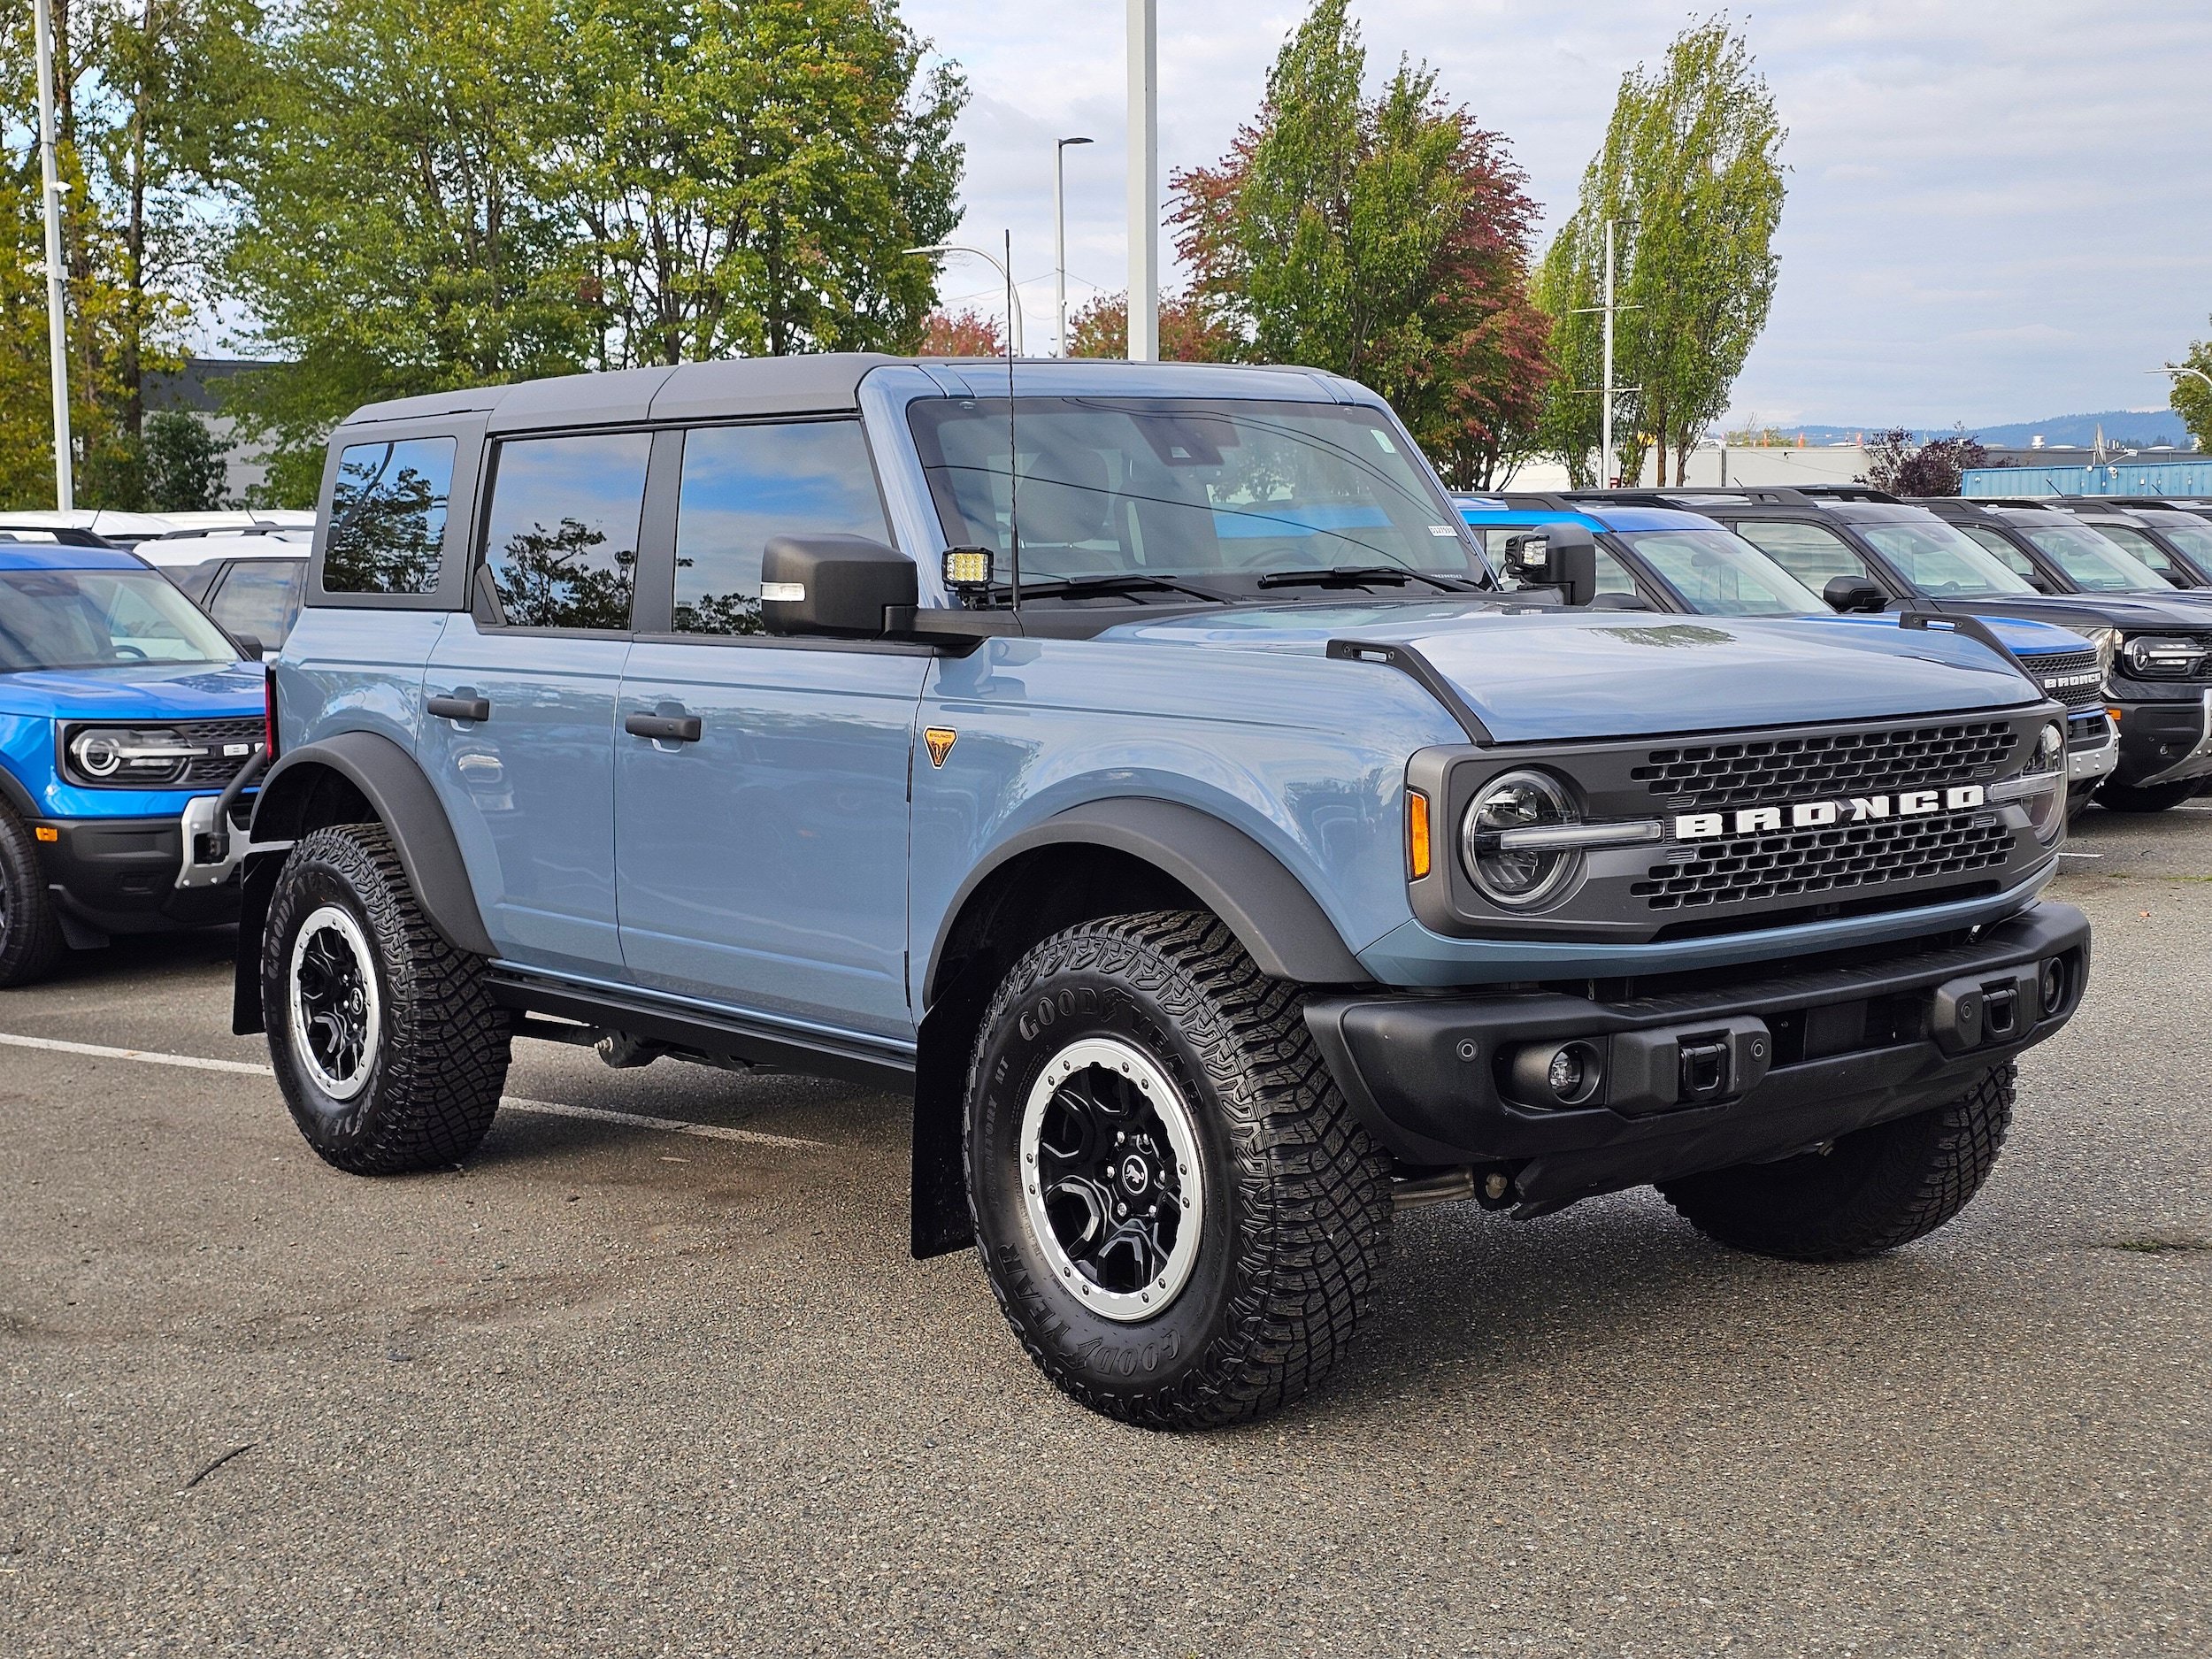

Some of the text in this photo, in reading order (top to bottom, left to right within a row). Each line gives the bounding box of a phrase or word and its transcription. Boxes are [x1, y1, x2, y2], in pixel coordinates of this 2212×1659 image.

[2044, 672, 2101, 688] BRONCO
[1675, 785, 1984, 840] BRONCO
[1018, 987, 1203, 1114] GOODYEAR
[997, 1242, 1181, 1377] GOODYEAR
